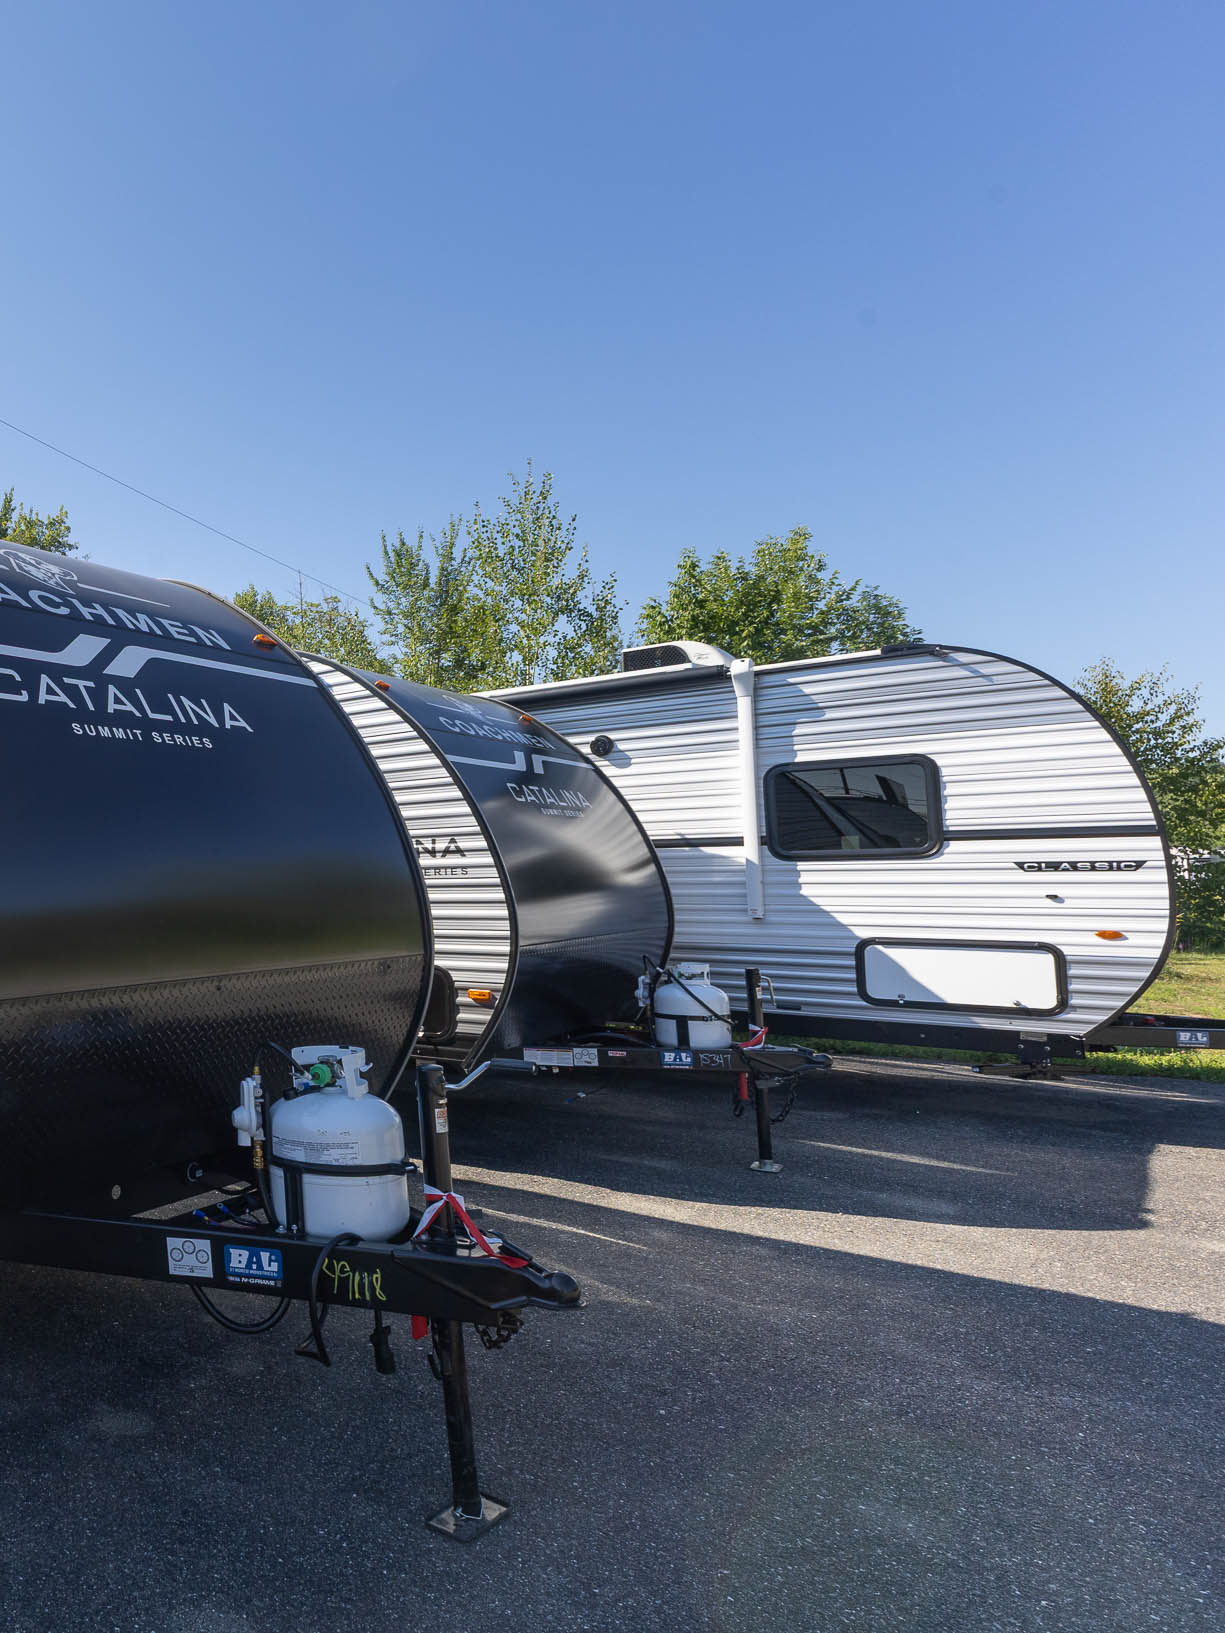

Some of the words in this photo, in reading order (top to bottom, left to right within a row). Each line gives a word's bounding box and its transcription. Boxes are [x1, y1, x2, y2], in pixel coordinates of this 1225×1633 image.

[72, 722, 143, 743] SUMMIT
[151, 732, 214, 750] SERIES
[438, 716, 557, 750] COACHMEN
[506, 782, 593, 809] CATALINA
[424, 867, 468, 877] ERIES
[1023, 861, 1137, 871] CLASSIC
[229, 1248, 279, 1272] BAL
